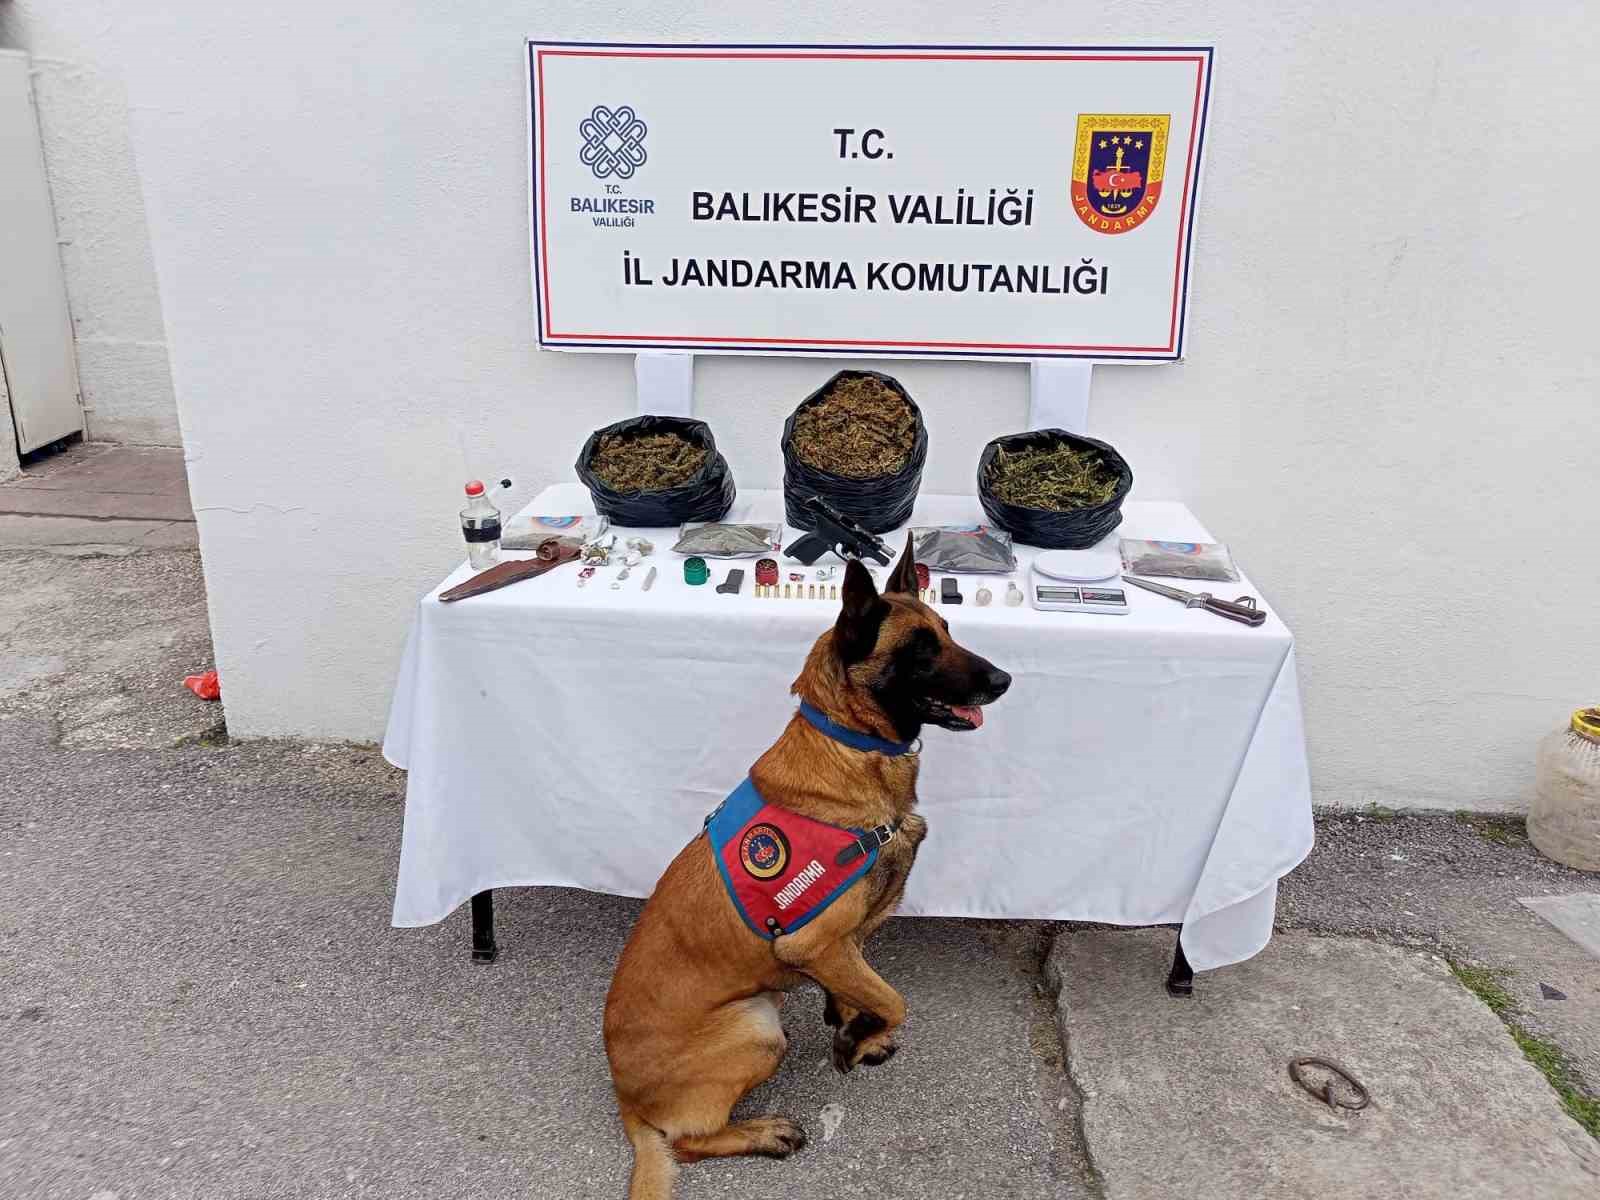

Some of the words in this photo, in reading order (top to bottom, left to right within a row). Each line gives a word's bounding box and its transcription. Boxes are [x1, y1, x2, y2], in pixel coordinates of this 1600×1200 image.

[834, 129, 893, 159] T.C.
[604, 184, 622, 194] T.C.
[693, 187, 876, 223] BALIKESİR
[888, 189, 1034, 226] VALİLİĞİ
[1075, 194, 1157, 231] JANDARMA
[623, 250, 653, 285] İL
[662, 258, 857, 290] JANDARMA
[867, 258, 1108, 295] KOMUTANLIĞI
[774, 859, 826, 910] JANDARMA
